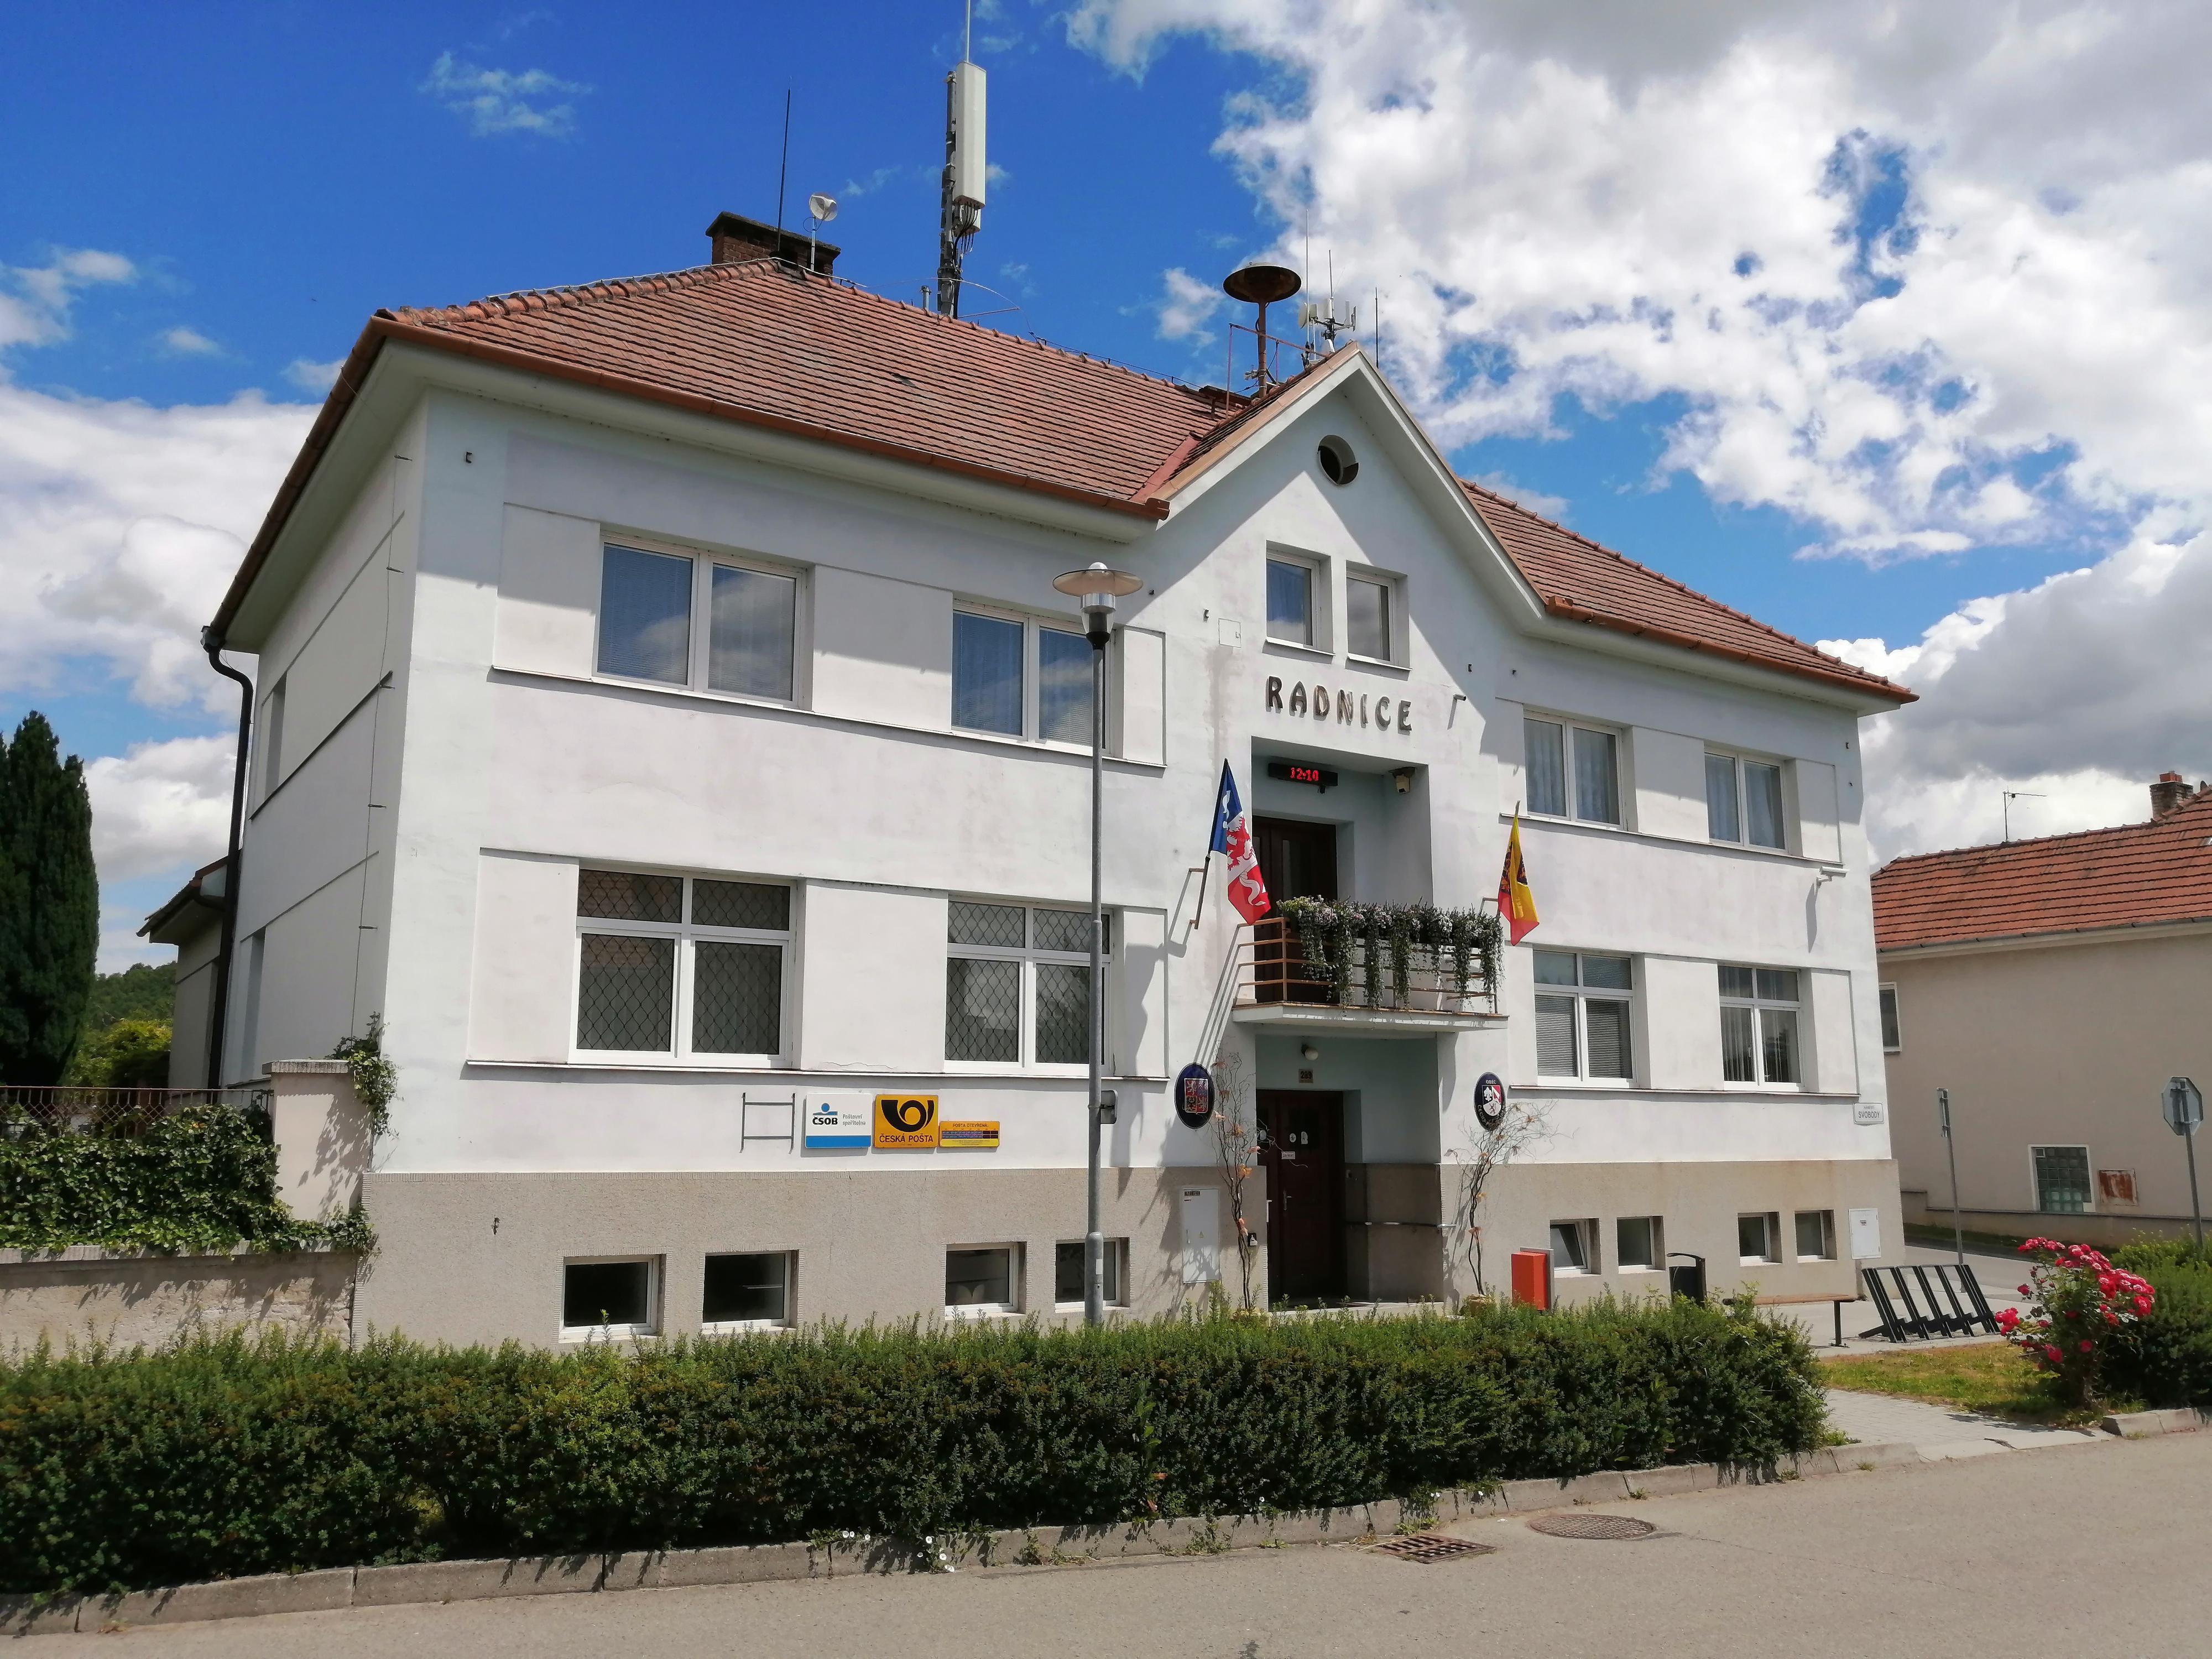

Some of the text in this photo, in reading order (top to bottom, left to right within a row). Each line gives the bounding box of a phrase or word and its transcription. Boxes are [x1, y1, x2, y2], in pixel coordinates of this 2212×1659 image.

[1268, 675, 1412, 731] RADNICE
[1290, 767, 1319, 781] 12:10
[812, 1116, 838, 1125] ČSOB
[879, 1133, 906, 1143] ČESKÁ
[908, 1133, 933, 1143] POŠTA
